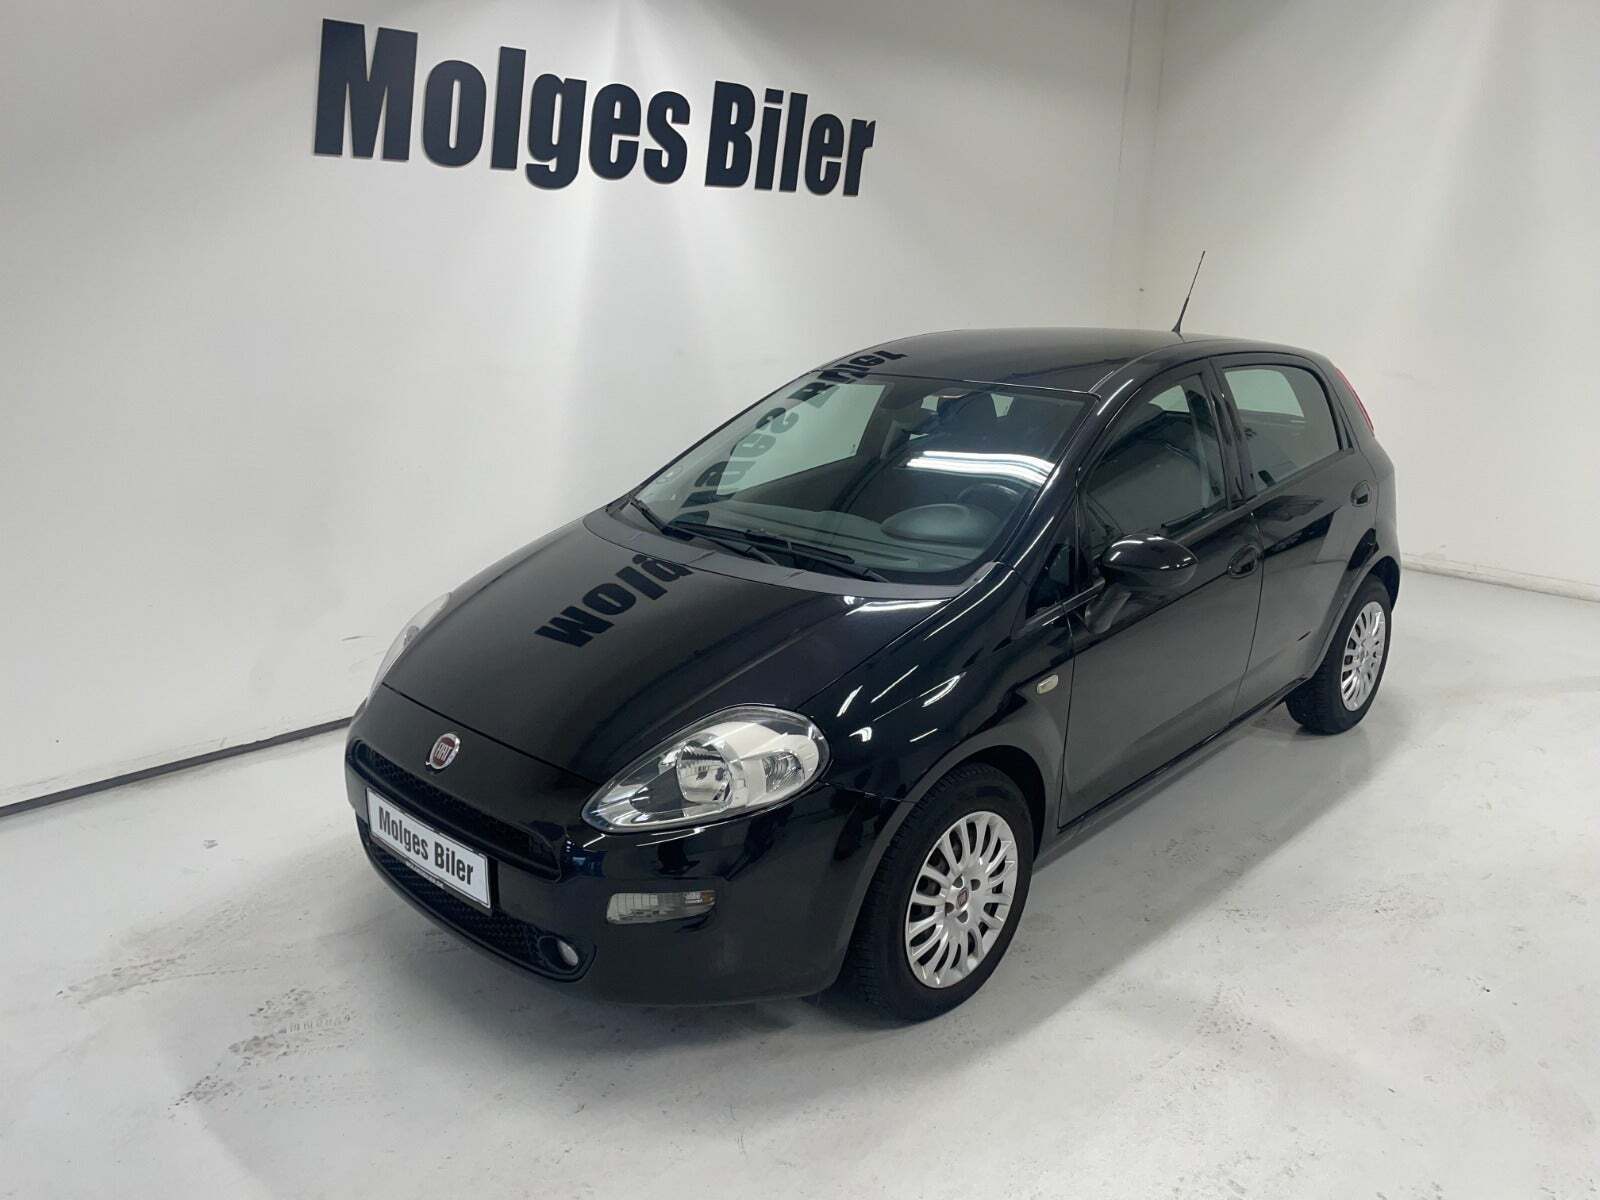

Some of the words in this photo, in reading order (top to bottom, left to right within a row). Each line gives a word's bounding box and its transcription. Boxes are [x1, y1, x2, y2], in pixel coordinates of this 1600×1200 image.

[314, 18, 691, 190] Molges
[704, 80, 876, 196] Biler
[434, 742, 453, 761] FIAT
[379, 806, 428, 860] Molges
[434, 841, 473, 885] Biler
